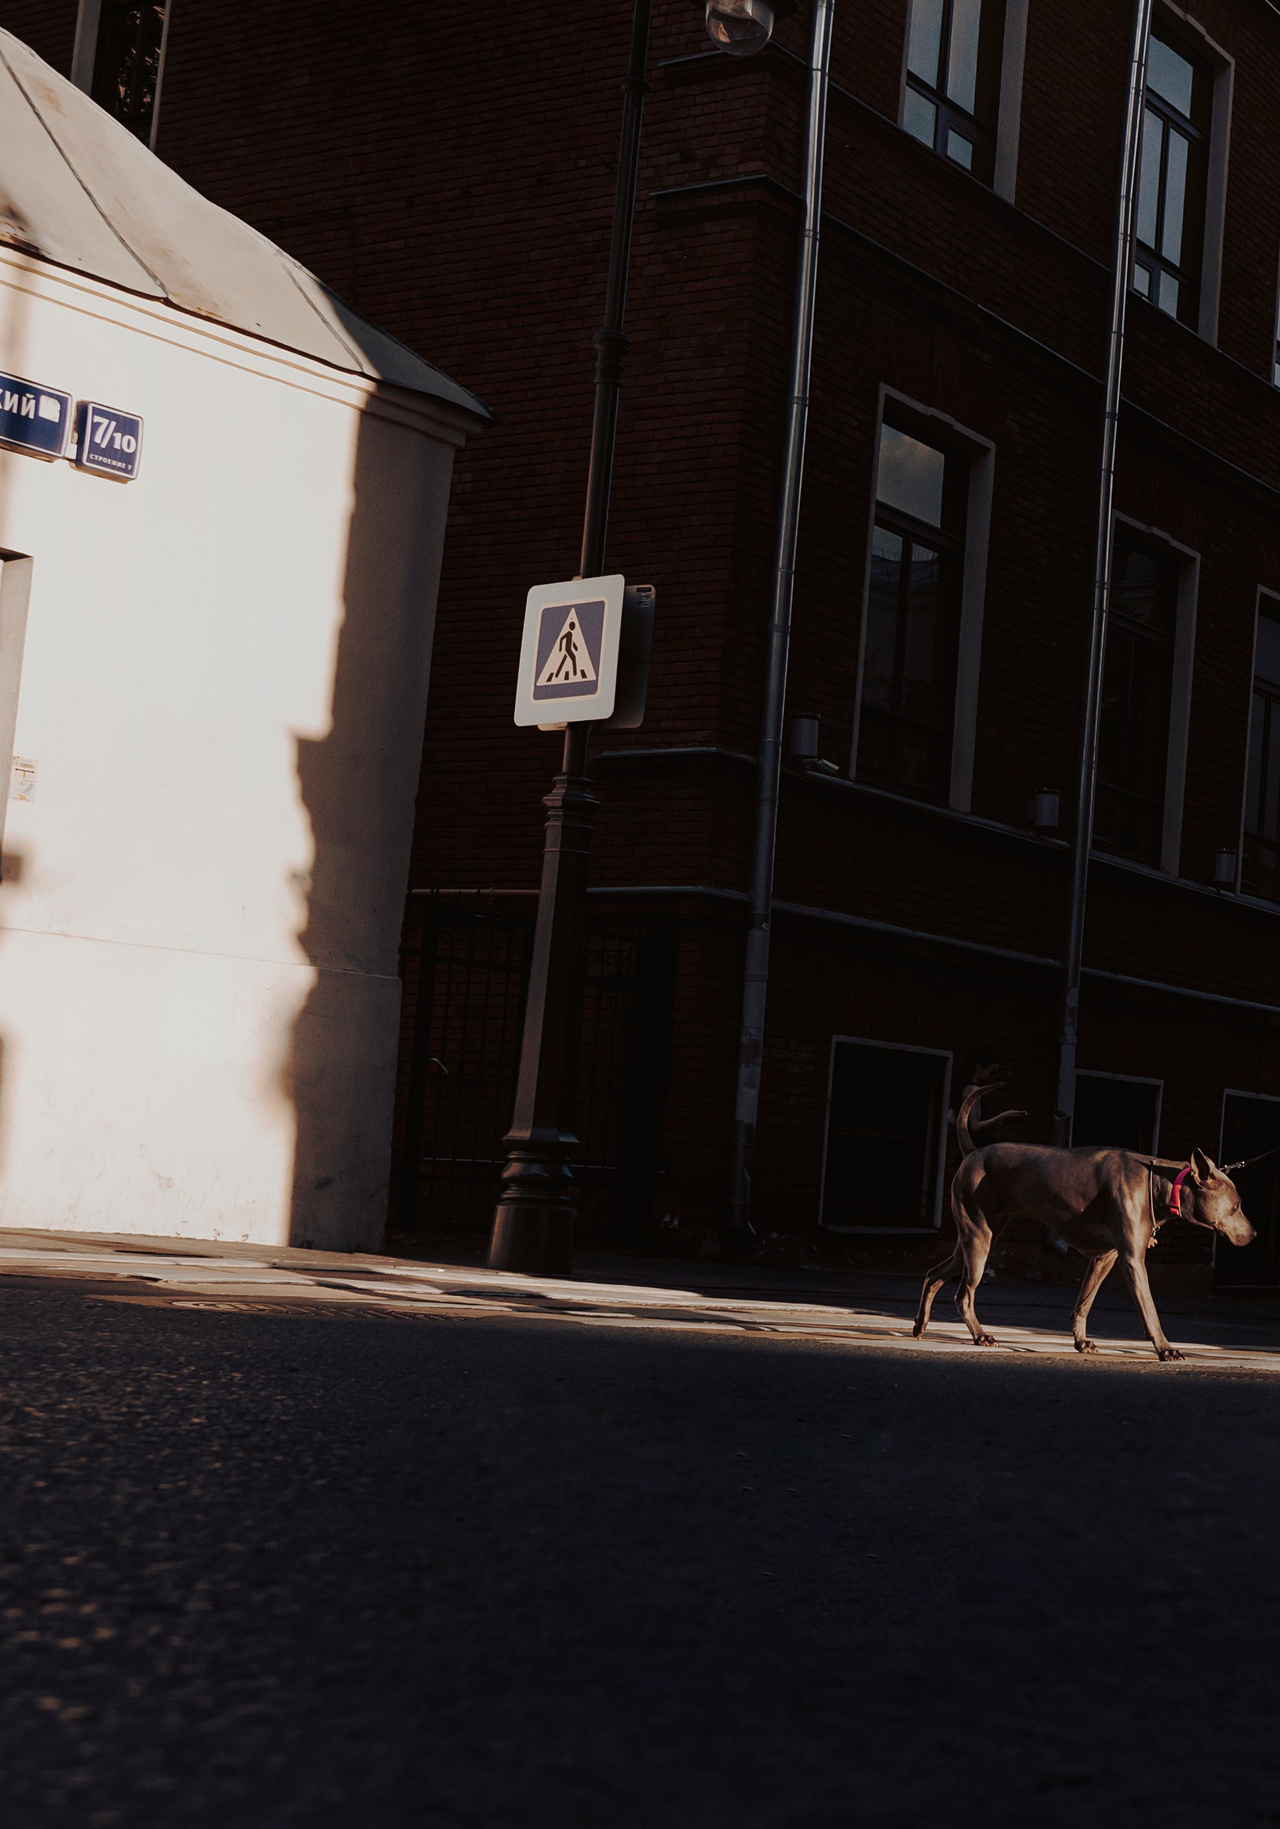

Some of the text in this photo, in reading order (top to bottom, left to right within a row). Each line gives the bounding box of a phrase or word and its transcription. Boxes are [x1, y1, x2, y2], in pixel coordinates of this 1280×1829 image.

[0, 388, 36, 419] ИЙ
[93, 415, 137, 454] 7/10
[89, 453, 126, 469] СТРОЕНИЕ
